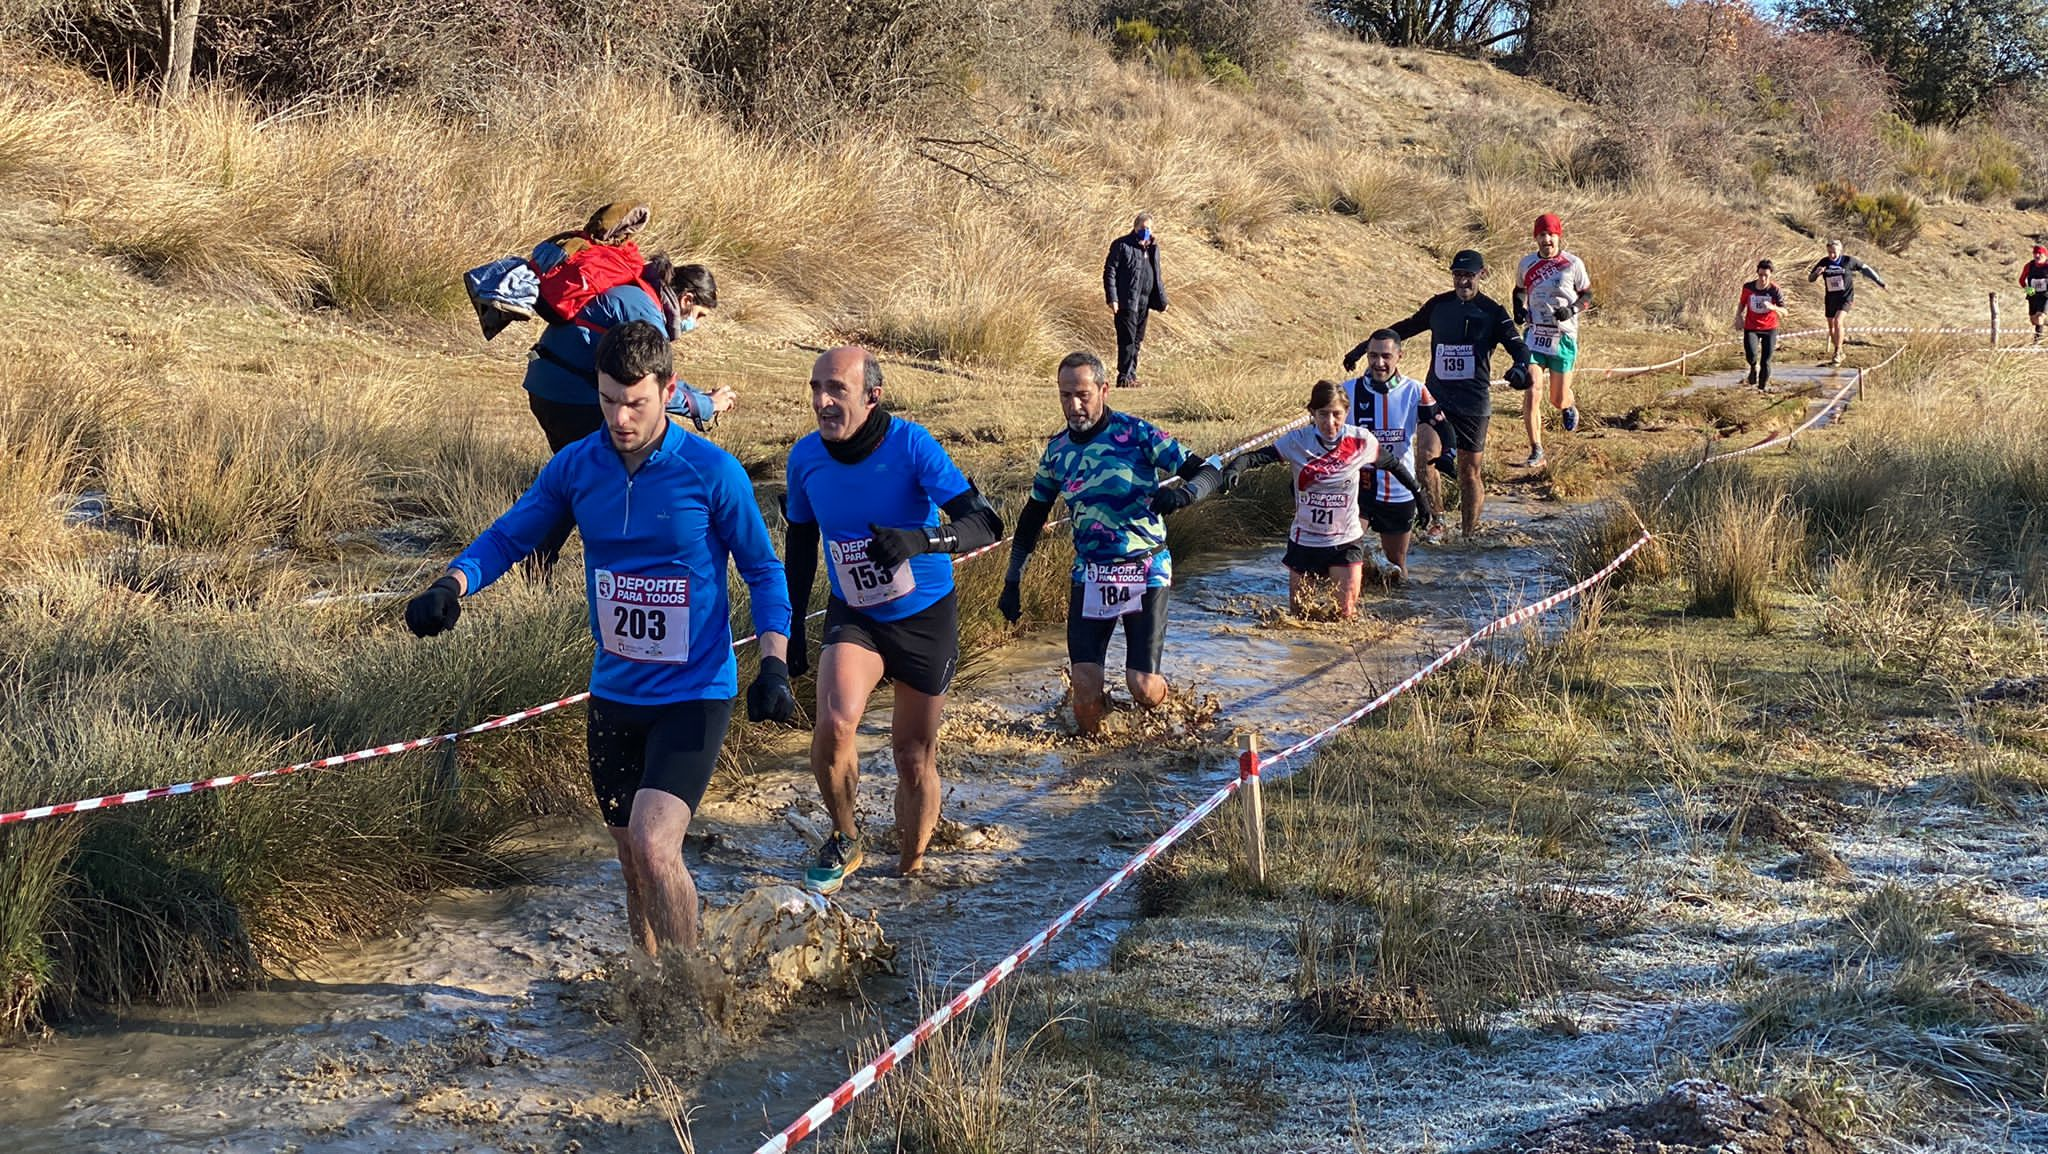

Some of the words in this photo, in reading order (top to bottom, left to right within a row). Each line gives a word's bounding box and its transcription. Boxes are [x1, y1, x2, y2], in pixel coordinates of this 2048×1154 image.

[1535, 336, 1552, 348] 190
[1443, 358, 1465, 371] 139
[1310, 508, 1333, 524] 121
[844, 552, 868, 562] PARA
[617, 575, 687, 593] DEPORTE
[1118, 574, 1145, 582] TODOS
[616, 589, 643, 602] PARA
[646, 592, 686, 604] TODOS
[1099, 585, 1131, 606] 184
[614, 605, 666, 641] 203
